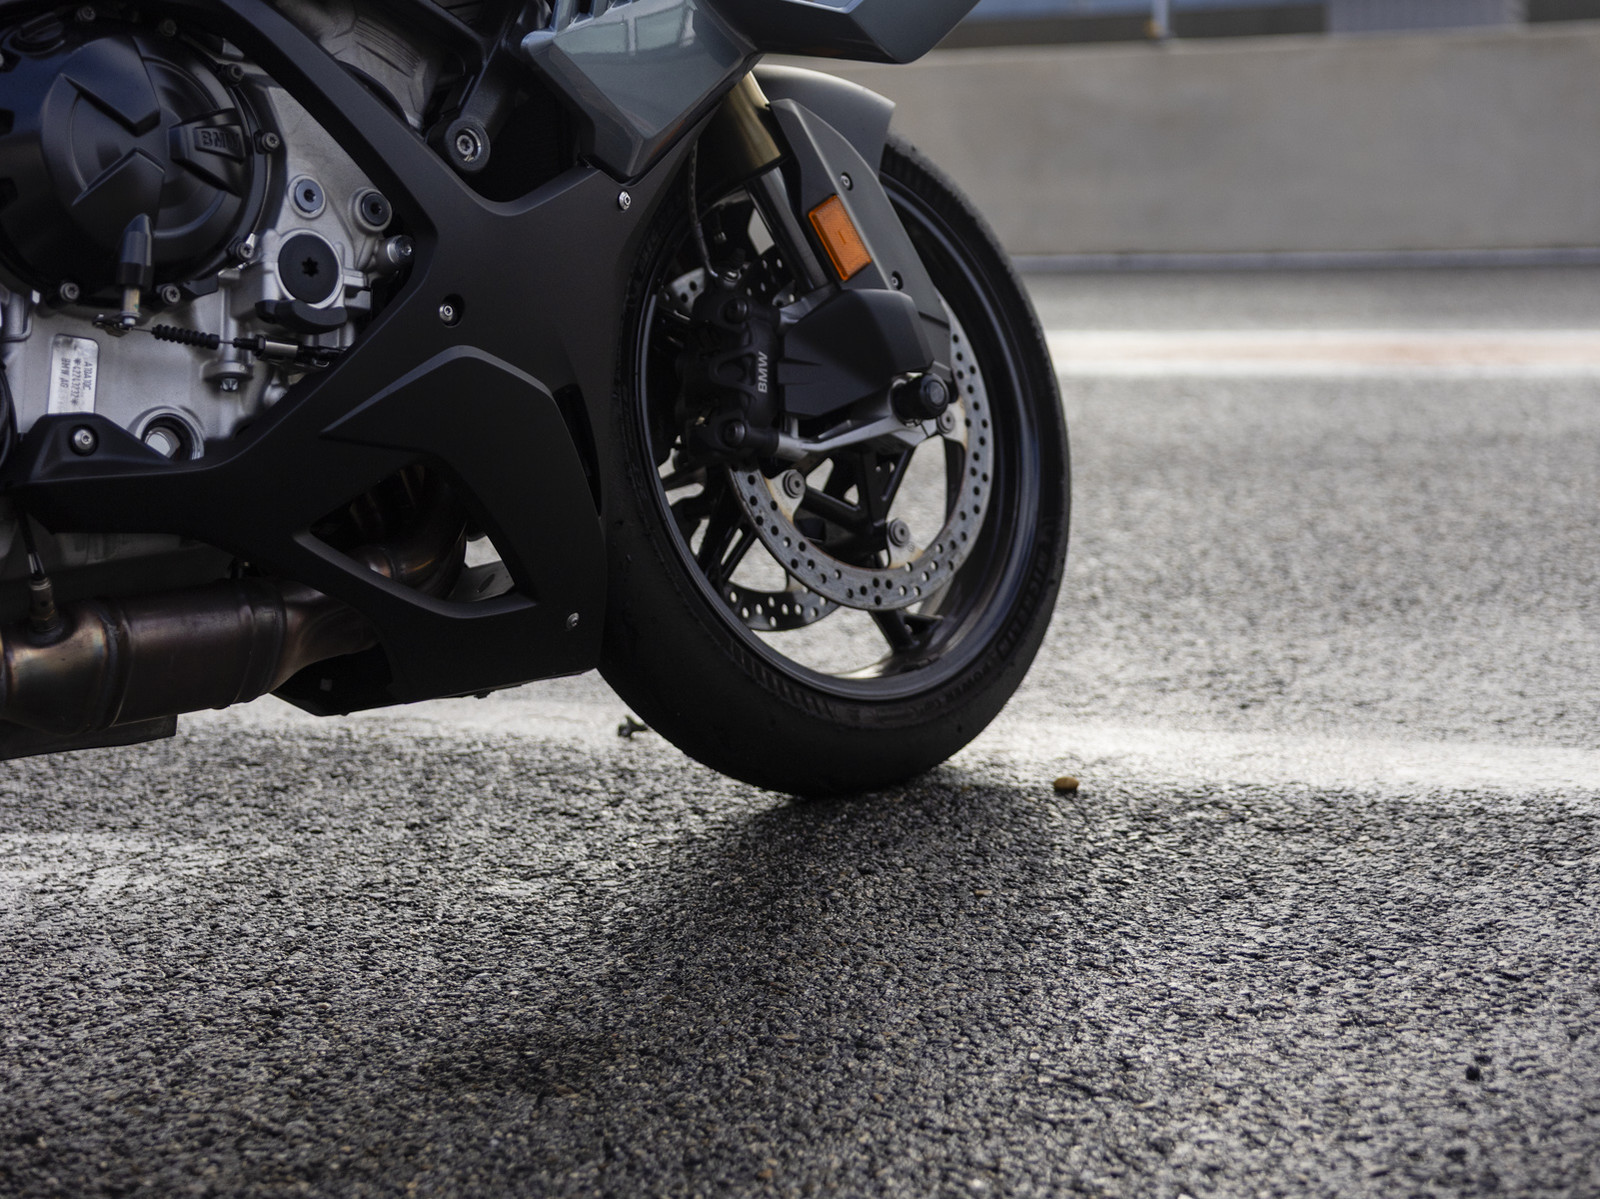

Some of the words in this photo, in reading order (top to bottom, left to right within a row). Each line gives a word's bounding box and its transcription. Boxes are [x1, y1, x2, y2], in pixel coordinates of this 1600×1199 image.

[201, 130, 240, 150] BMW
[61, 357, 71, 376] BMW
[757, 350, 769, 394] BMW
